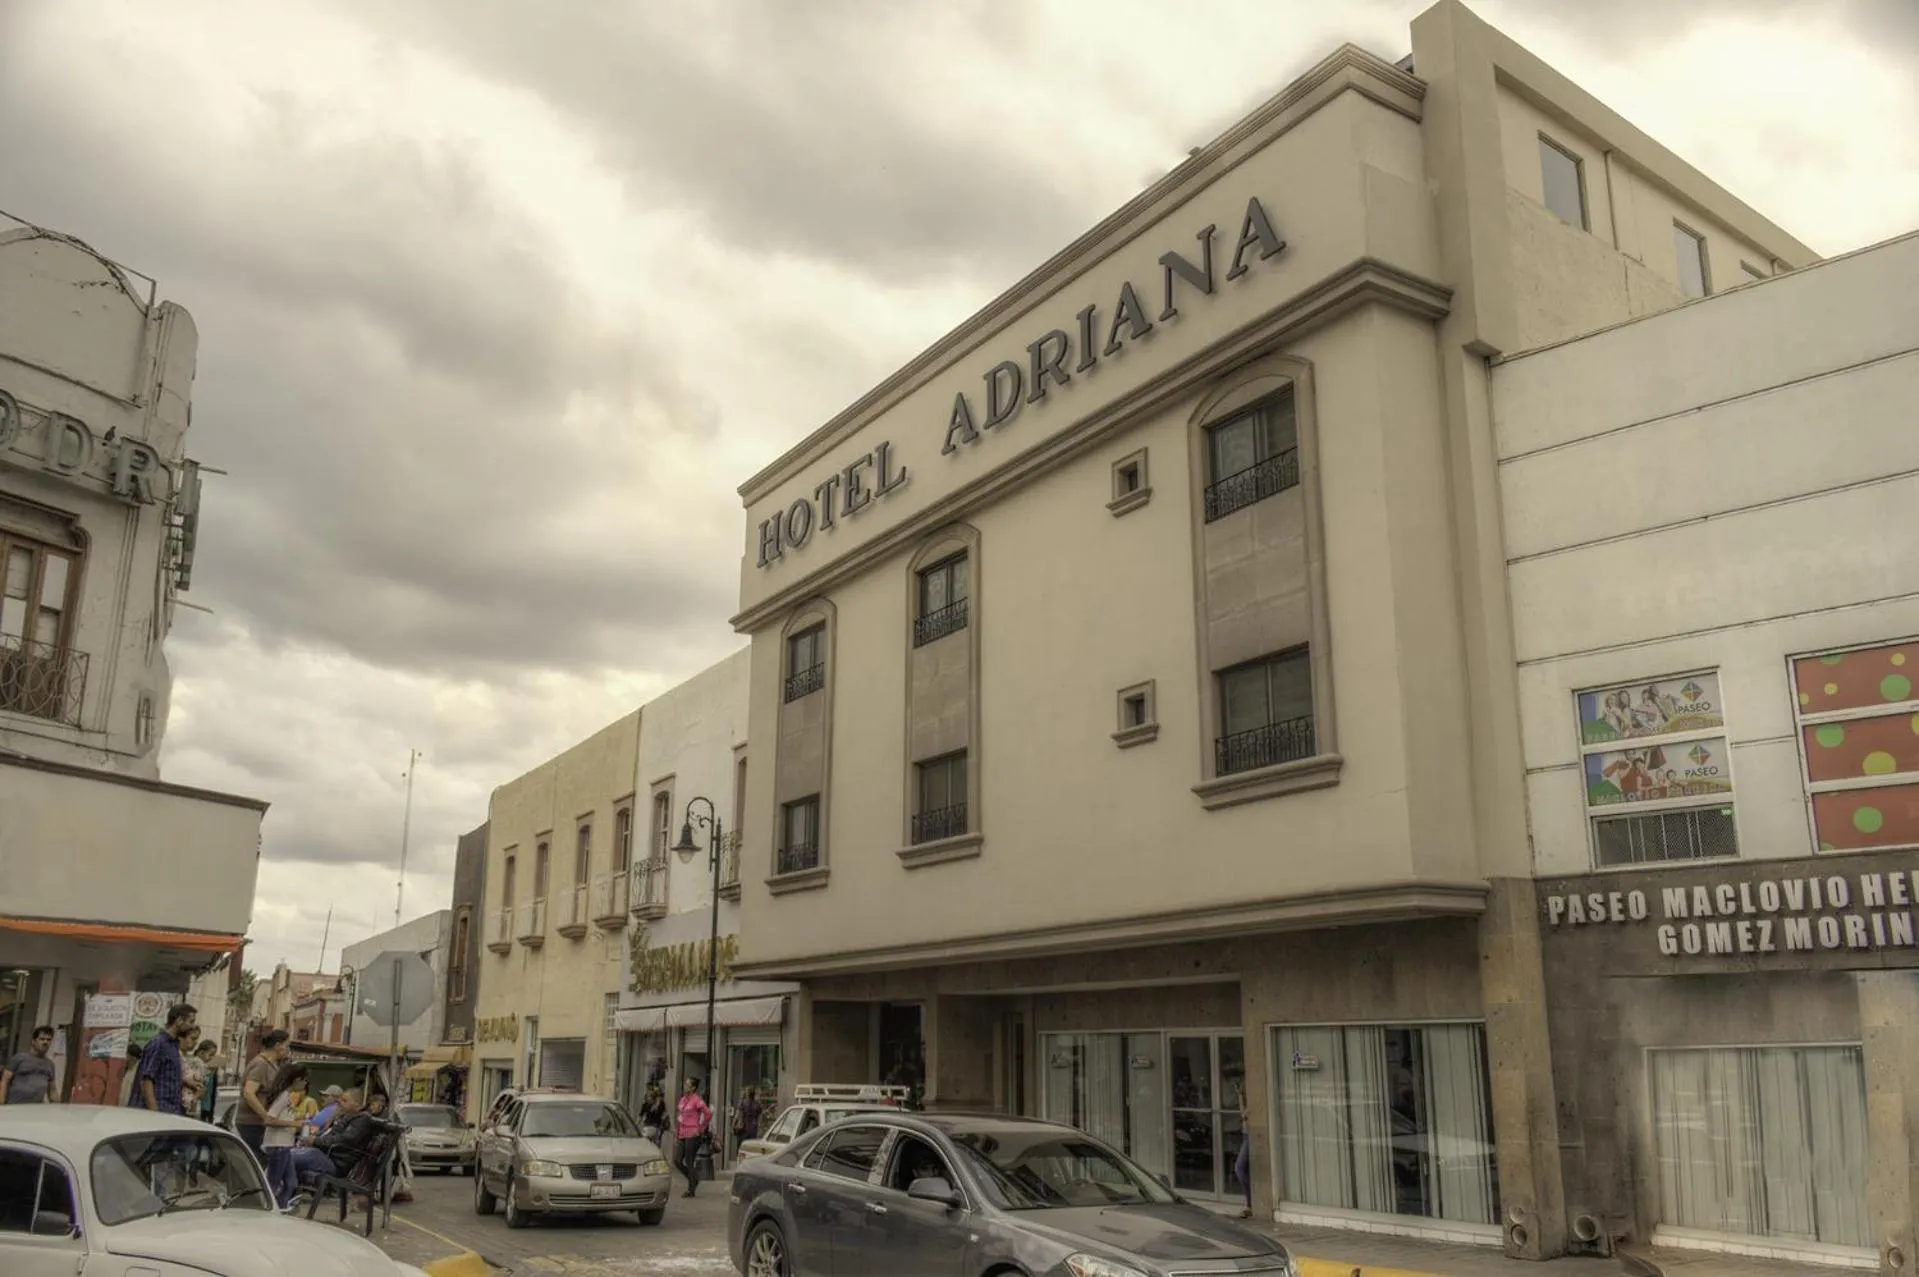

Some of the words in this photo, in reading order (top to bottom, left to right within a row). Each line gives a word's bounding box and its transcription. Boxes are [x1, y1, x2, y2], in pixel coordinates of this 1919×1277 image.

[757, 440, 908, 568] HOTEL
[940, 196, 1287, 456] ADRIANA
[1678, 701, 1711, 714] PASEO
[1684, 765, 1718, 778] PASEO
[1547, 889, 1648, 926] PASEO
[1662, 875, 1850, 918] MACLOVIO
[1657, 918, 1777, 956] GOMEZ
[1784, 911, 1915, 950] MORIN
